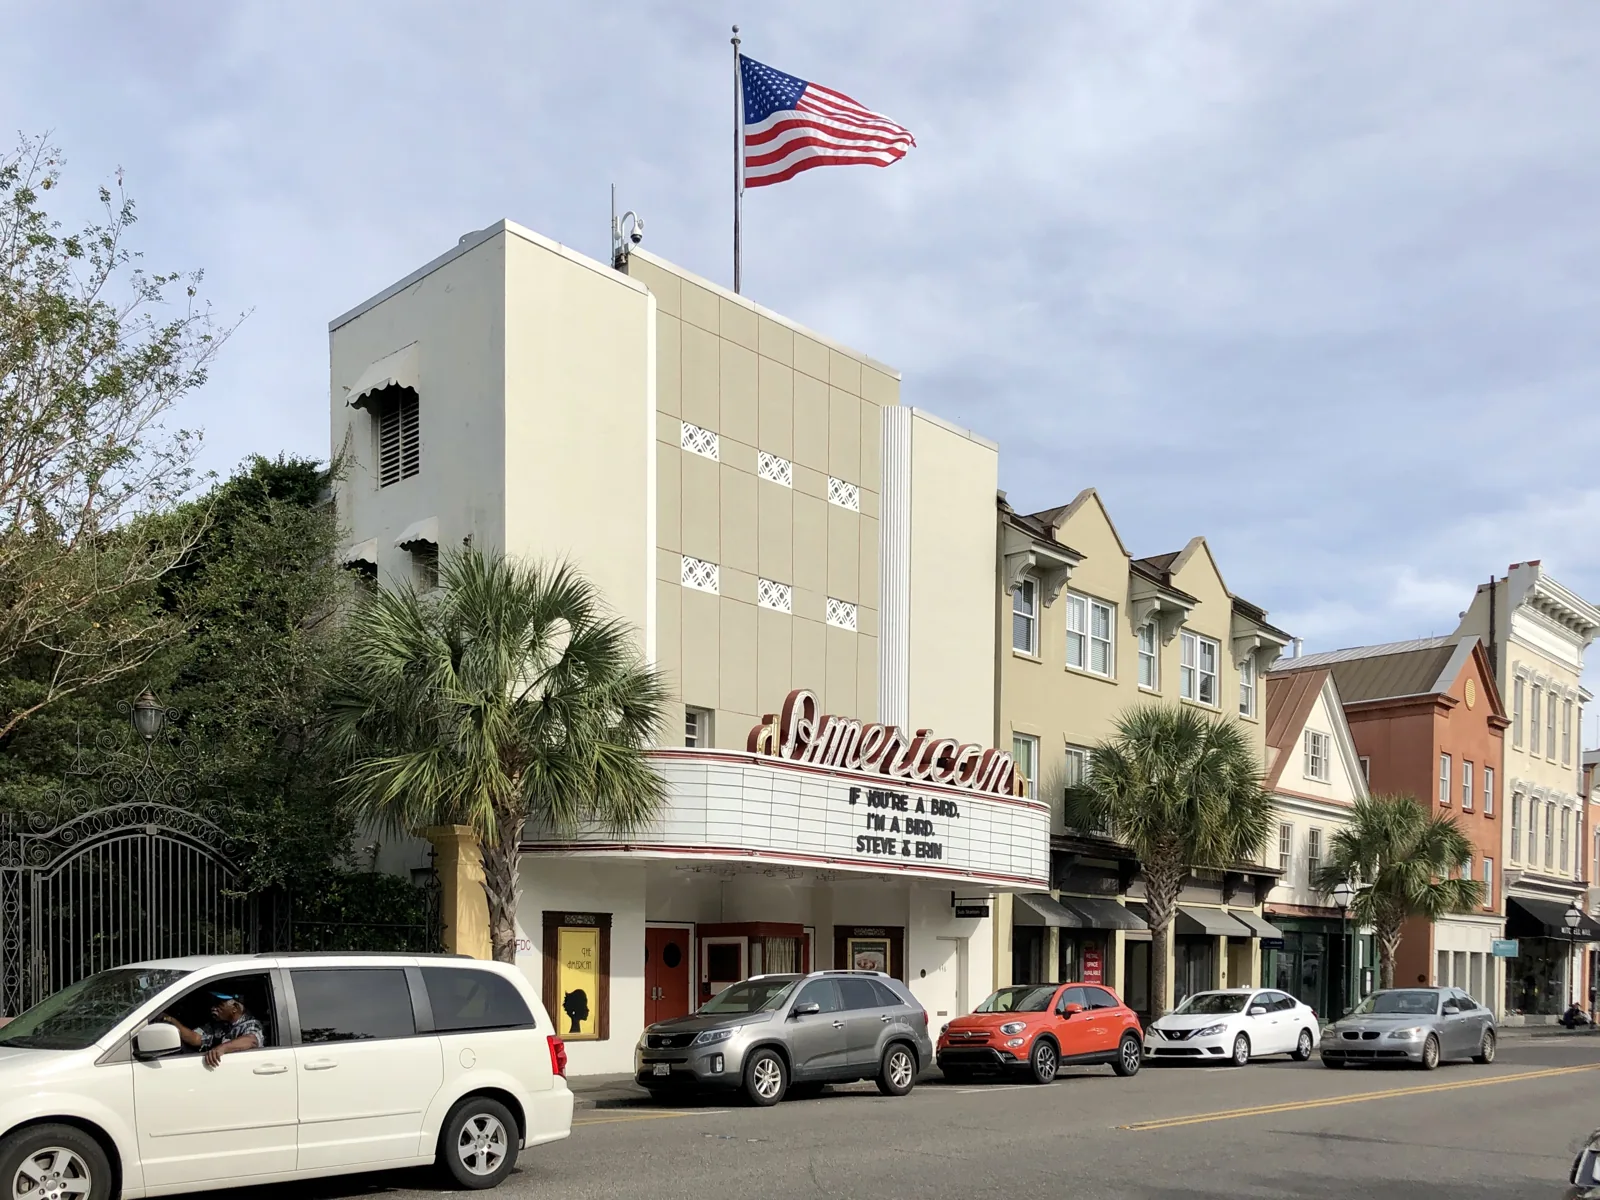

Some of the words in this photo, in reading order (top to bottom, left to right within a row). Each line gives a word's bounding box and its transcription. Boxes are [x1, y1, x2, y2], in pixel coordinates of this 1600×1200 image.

[780, 689, 1013, 795] American
[849, 787, 861, 805] IF
[866, 790, 908, 812] YOU'RE
[915, 797, 925, 814] A
[931, 799, 960, 819] BIRD,
[867, 813, 885, 831] I'M
[890, 816, 900, 833] A
[906, 818, 935, 837] BIRD.
[856, 835, 897, 855] STEVE
[902, 840, 911, 857] &
[916, 841, 942, 860] ERIN
